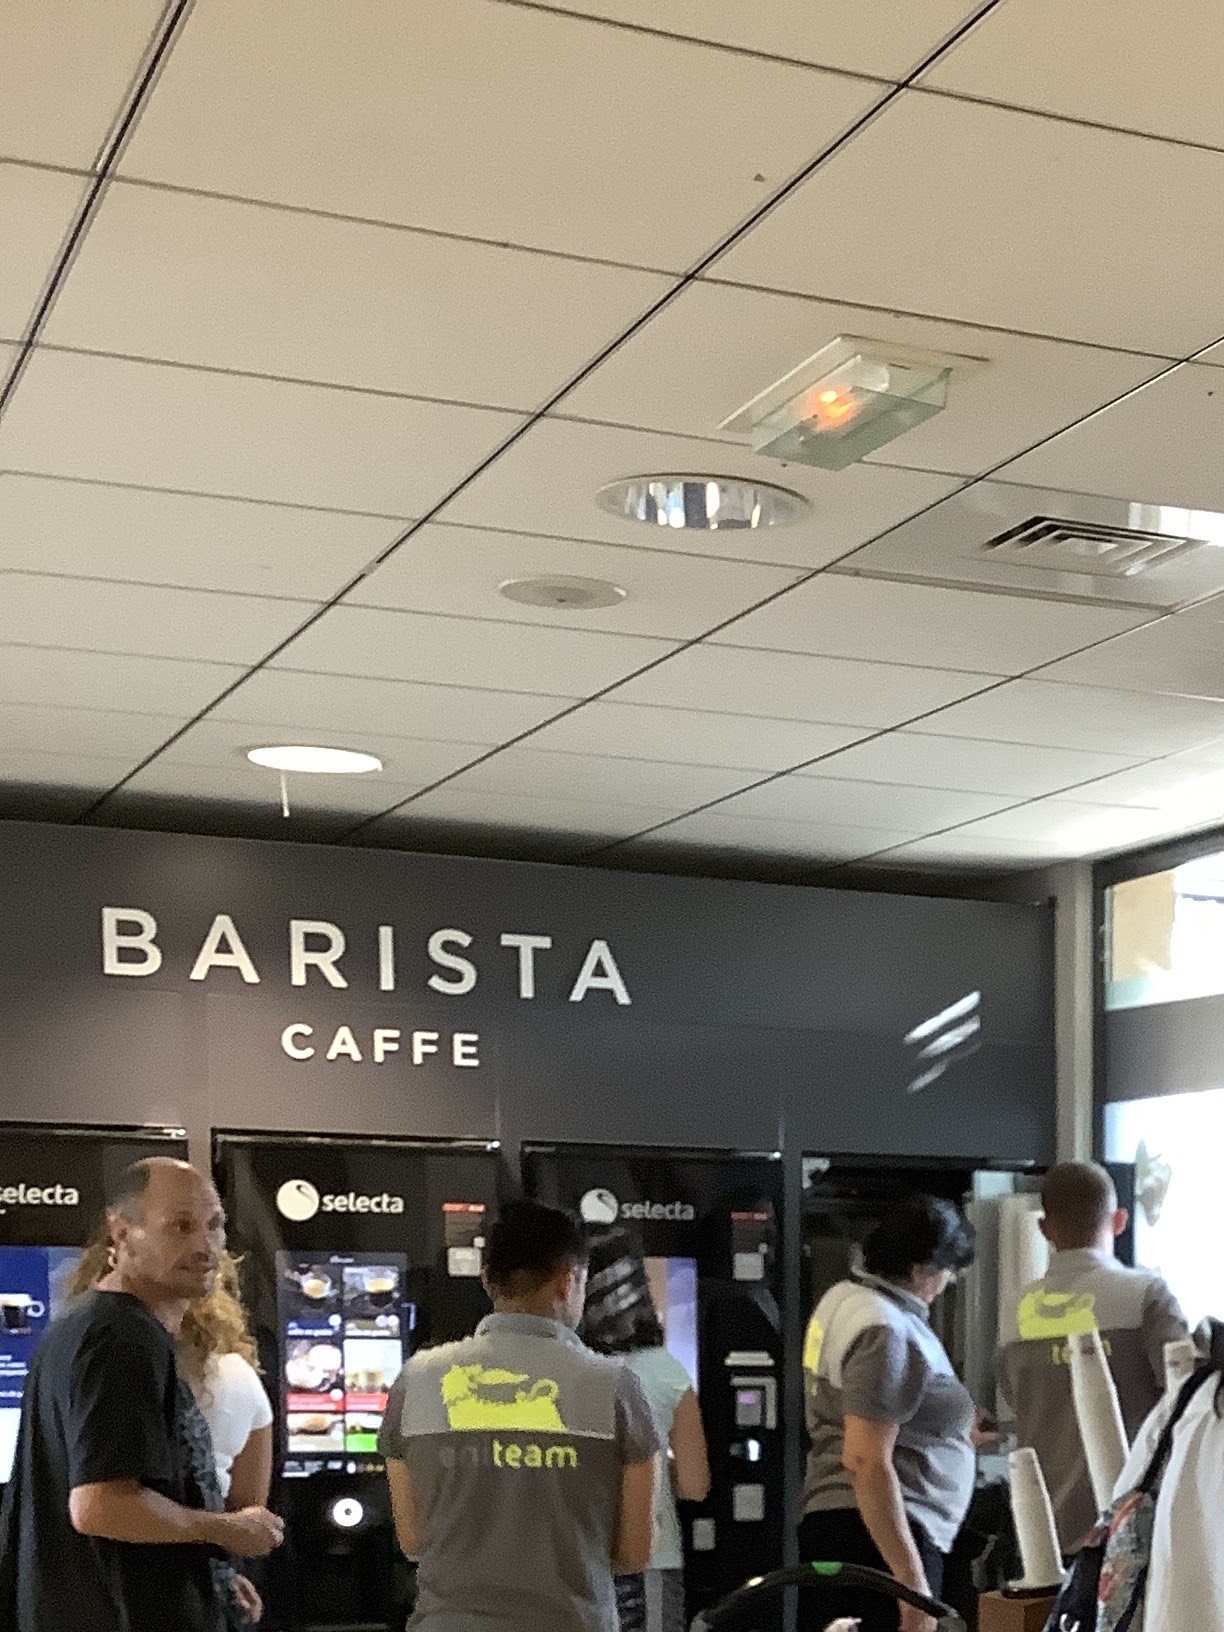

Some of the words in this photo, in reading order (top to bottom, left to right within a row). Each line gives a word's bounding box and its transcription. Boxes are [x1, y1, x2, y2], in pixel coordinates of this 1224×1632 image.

[100, 905, 633, 1006] BARISTA
[280, 1022, 481, 1068] CAFFE
[321, 1191, 405, 1214] selecta
[620, 1200, 695, 1221] selecta
[492, 1437, 579, 1469] team
